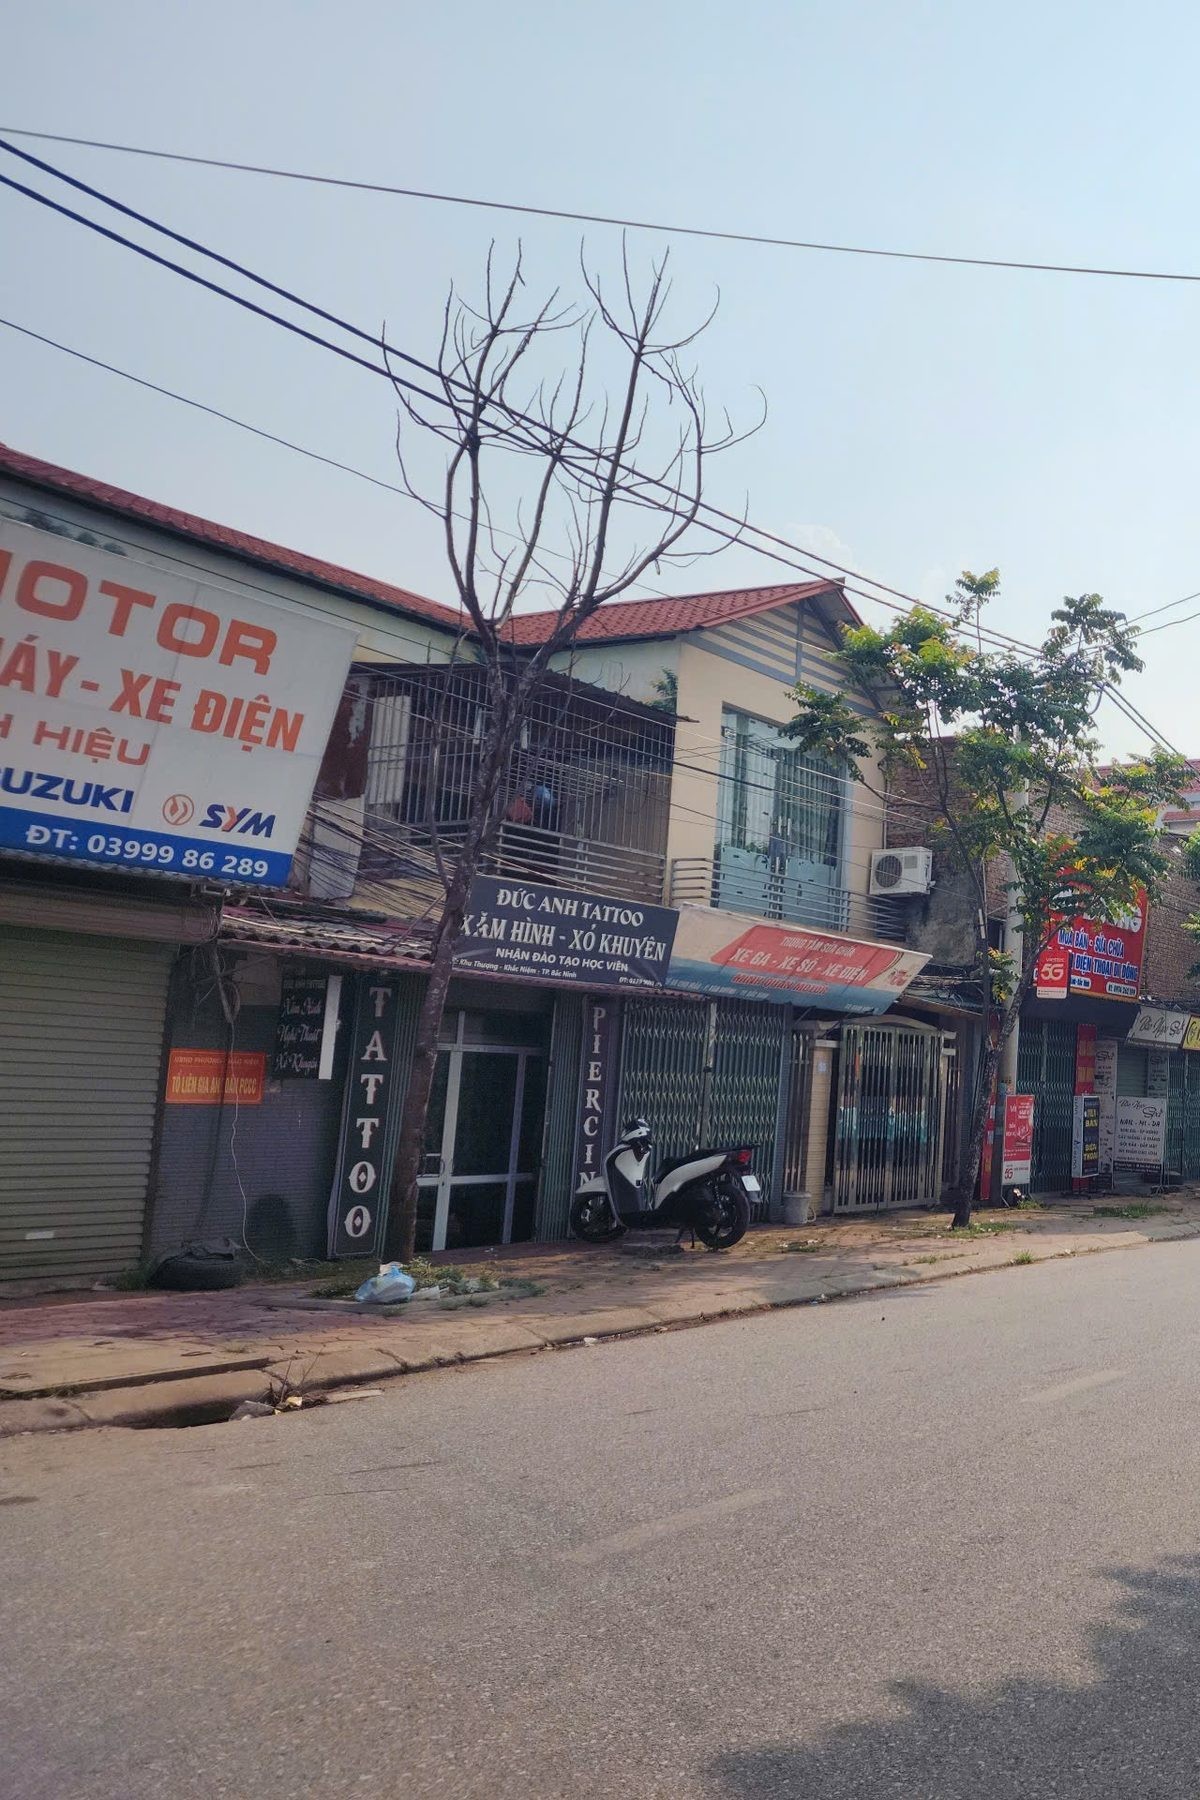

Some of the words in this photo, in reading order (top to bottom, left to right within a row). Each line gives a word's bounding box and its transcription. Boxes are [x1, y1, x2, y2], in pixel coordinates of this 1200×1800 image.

[0, 550, 277, 676] OTOR
[0, 633, 79, 698] ÁY
[109, 668, 182, 725] XE
[190, 689, 305, 753] ĐIỆN
[33, 720, 151, 766] HIỆU
[0, 766, 135, 814] UZUKI
[198, 803, 277, 839] SYM
[25, 824, 79, 851] ĐT:
[87, 835, 175, 864] 03999
[182, 847, 215, 870] 86
[221, 854, 269, 878] 289
[496, 888, 536, 910] ĐỨC
[538, 897, 578, 918] ANH
[579, 902, 644, 928] TATTOO
[495, 947, 530, 962] NHẬN
[532, 950, 556, 964] ĐÀO
[559, 954, 579, 968] TẠO
[582, 958, 604, 971] HỌC
[606, 960, 629, 973] VIÊN
[510, 917, 556, 947] HÌNH
[568, 924, 597, 952] XỎ
[598, 934, 667, 962] KHUYÊN
[730, 948, 753, 962] XE
[750, 951, 772, 965] GA
[778, 955, 798, 970] XE
[821, 962, 842, 977] XE
[1040, 963, 1065, 981] 5G
[344, 987, 392, 1238] TATTOO
[577, 1007, 606, 1222] PIERCIN
